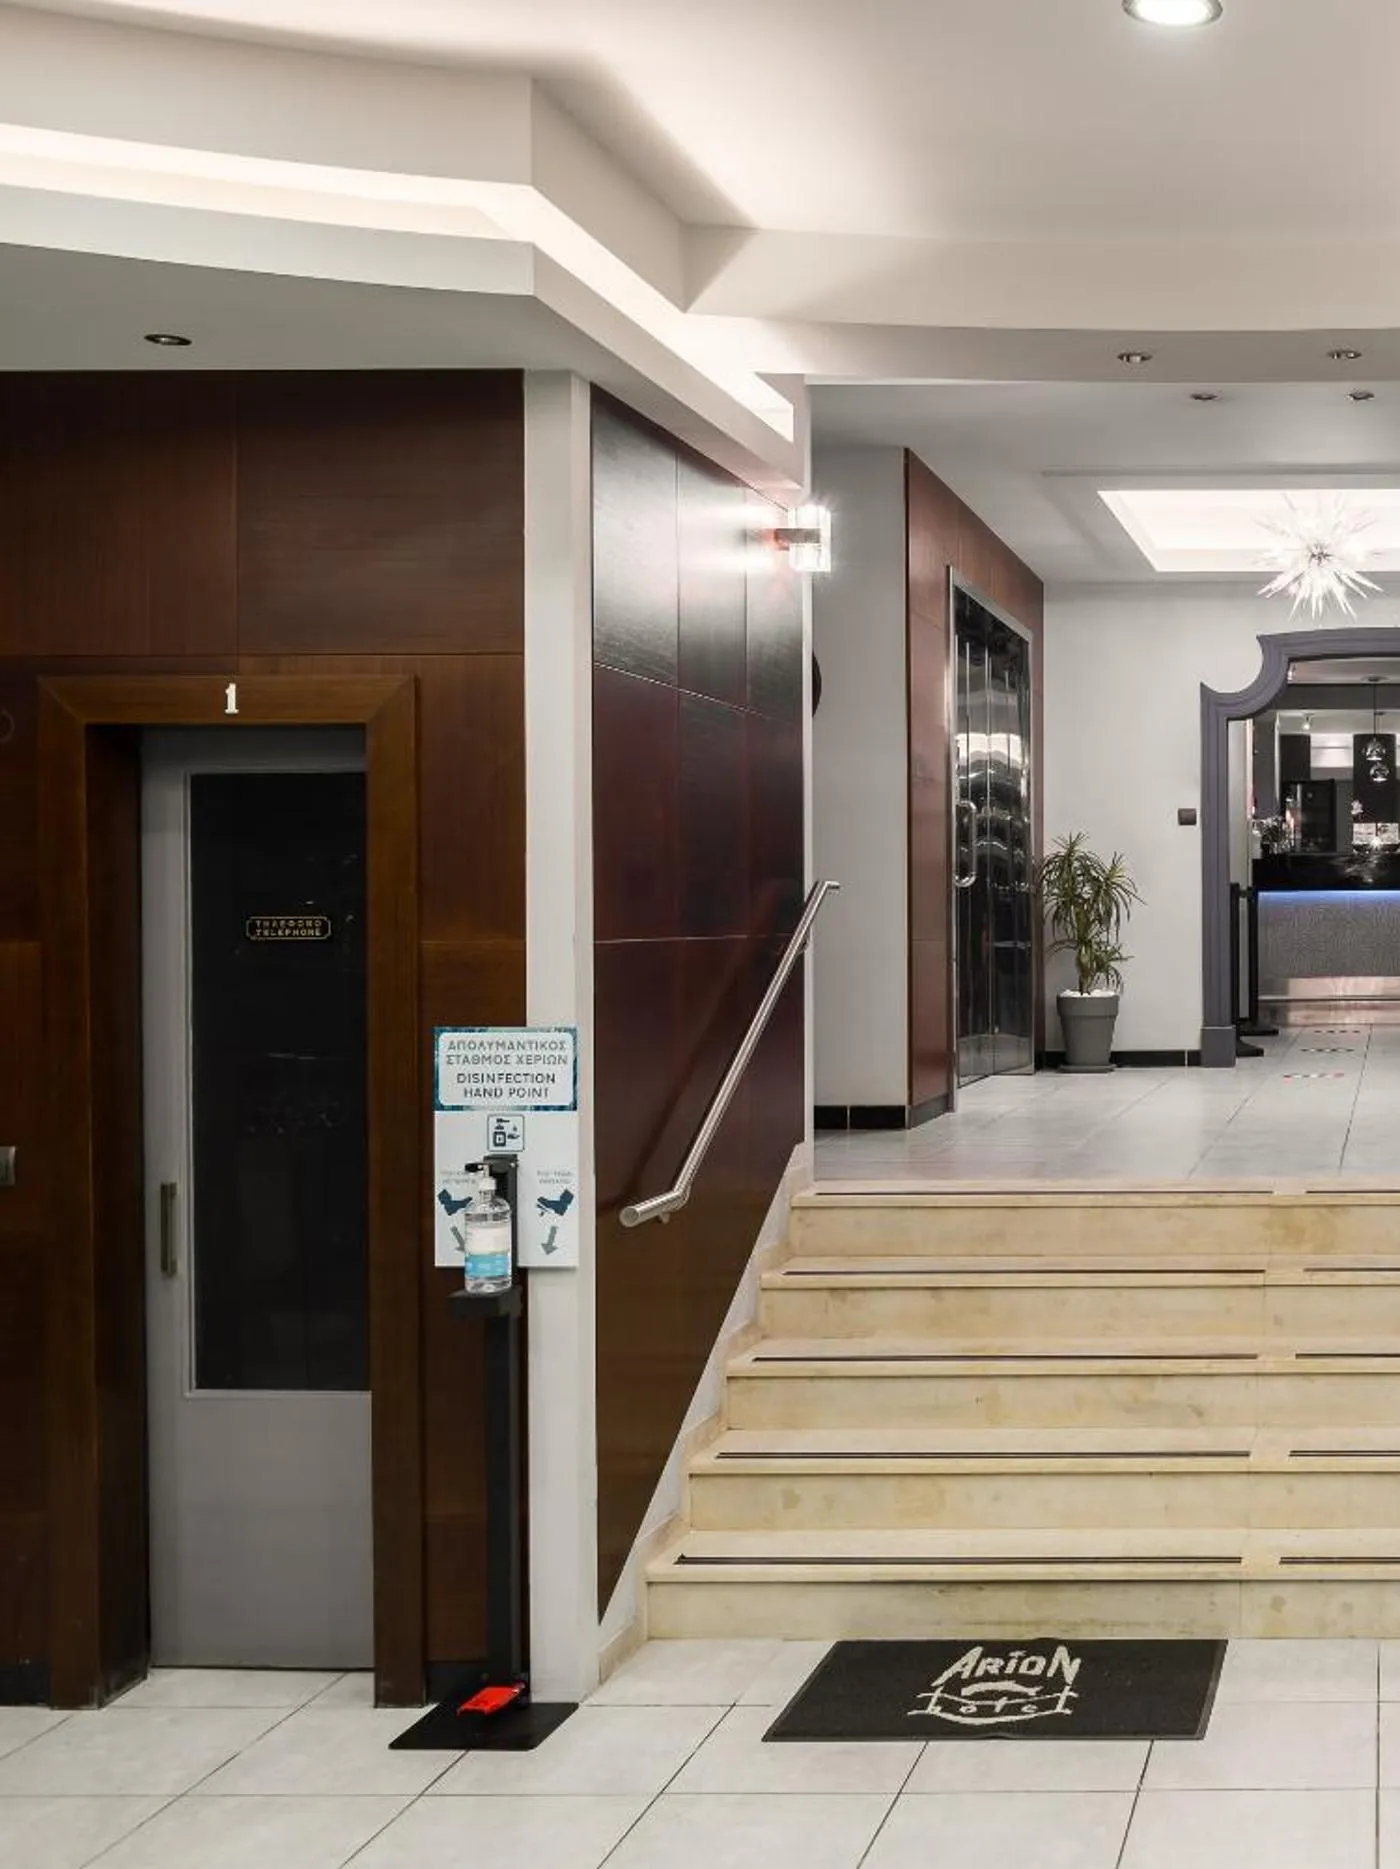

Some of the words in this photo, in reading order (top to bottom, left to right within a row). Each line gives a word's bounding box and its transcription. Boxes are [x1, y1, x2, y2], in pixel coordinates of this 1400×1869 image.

[224, 682, 239, 714] 1
[255, 928, 322, 937] TELEPHONE
[456, 1072, 556, 1084] DISINFECTION
[463, 1087, 503, 1098] HAND
[508, 1087, 549, 1099] POINT
